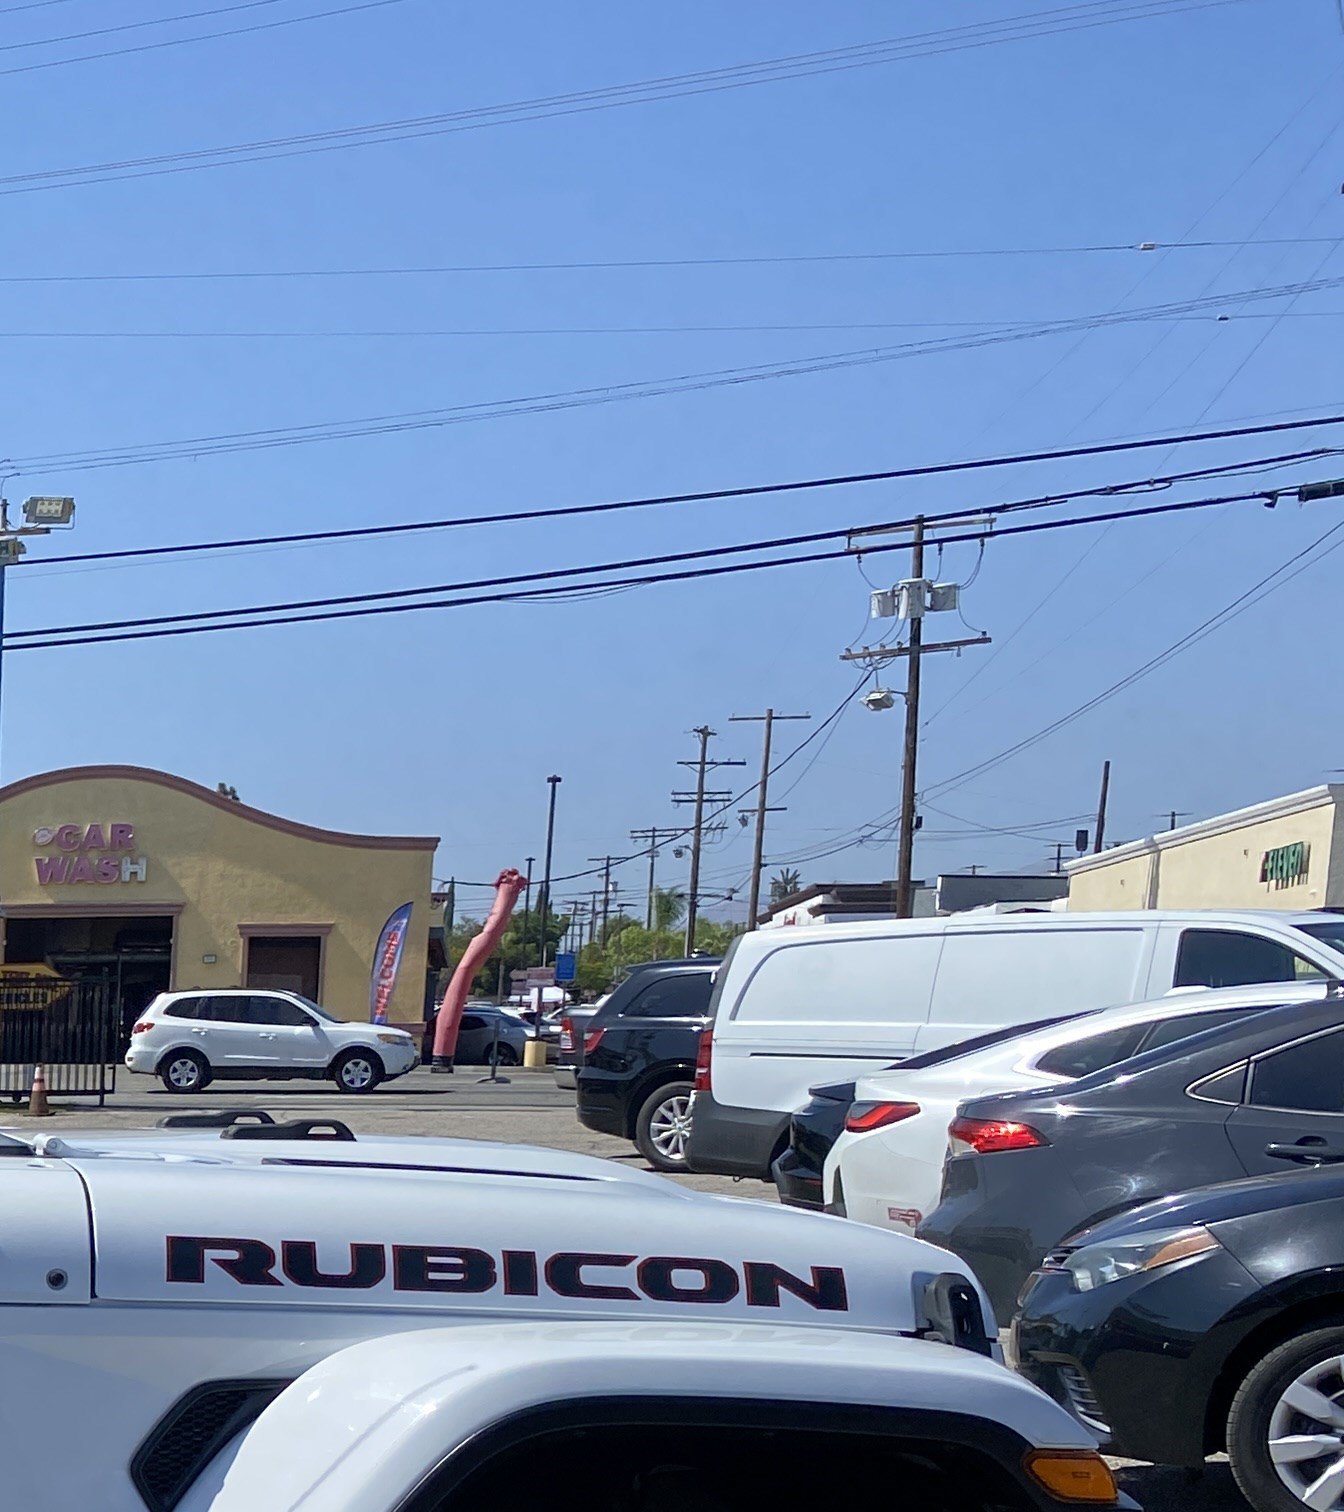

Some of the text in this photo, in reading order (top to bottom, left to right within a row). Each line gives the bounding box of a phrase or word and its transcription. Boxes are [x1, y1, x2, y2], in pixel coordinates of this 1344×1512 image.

[55, 822, 135, 852] CAR
[33, 856, 148, 886] WASH
[165, 1235, 850, 1312] RUBICON
